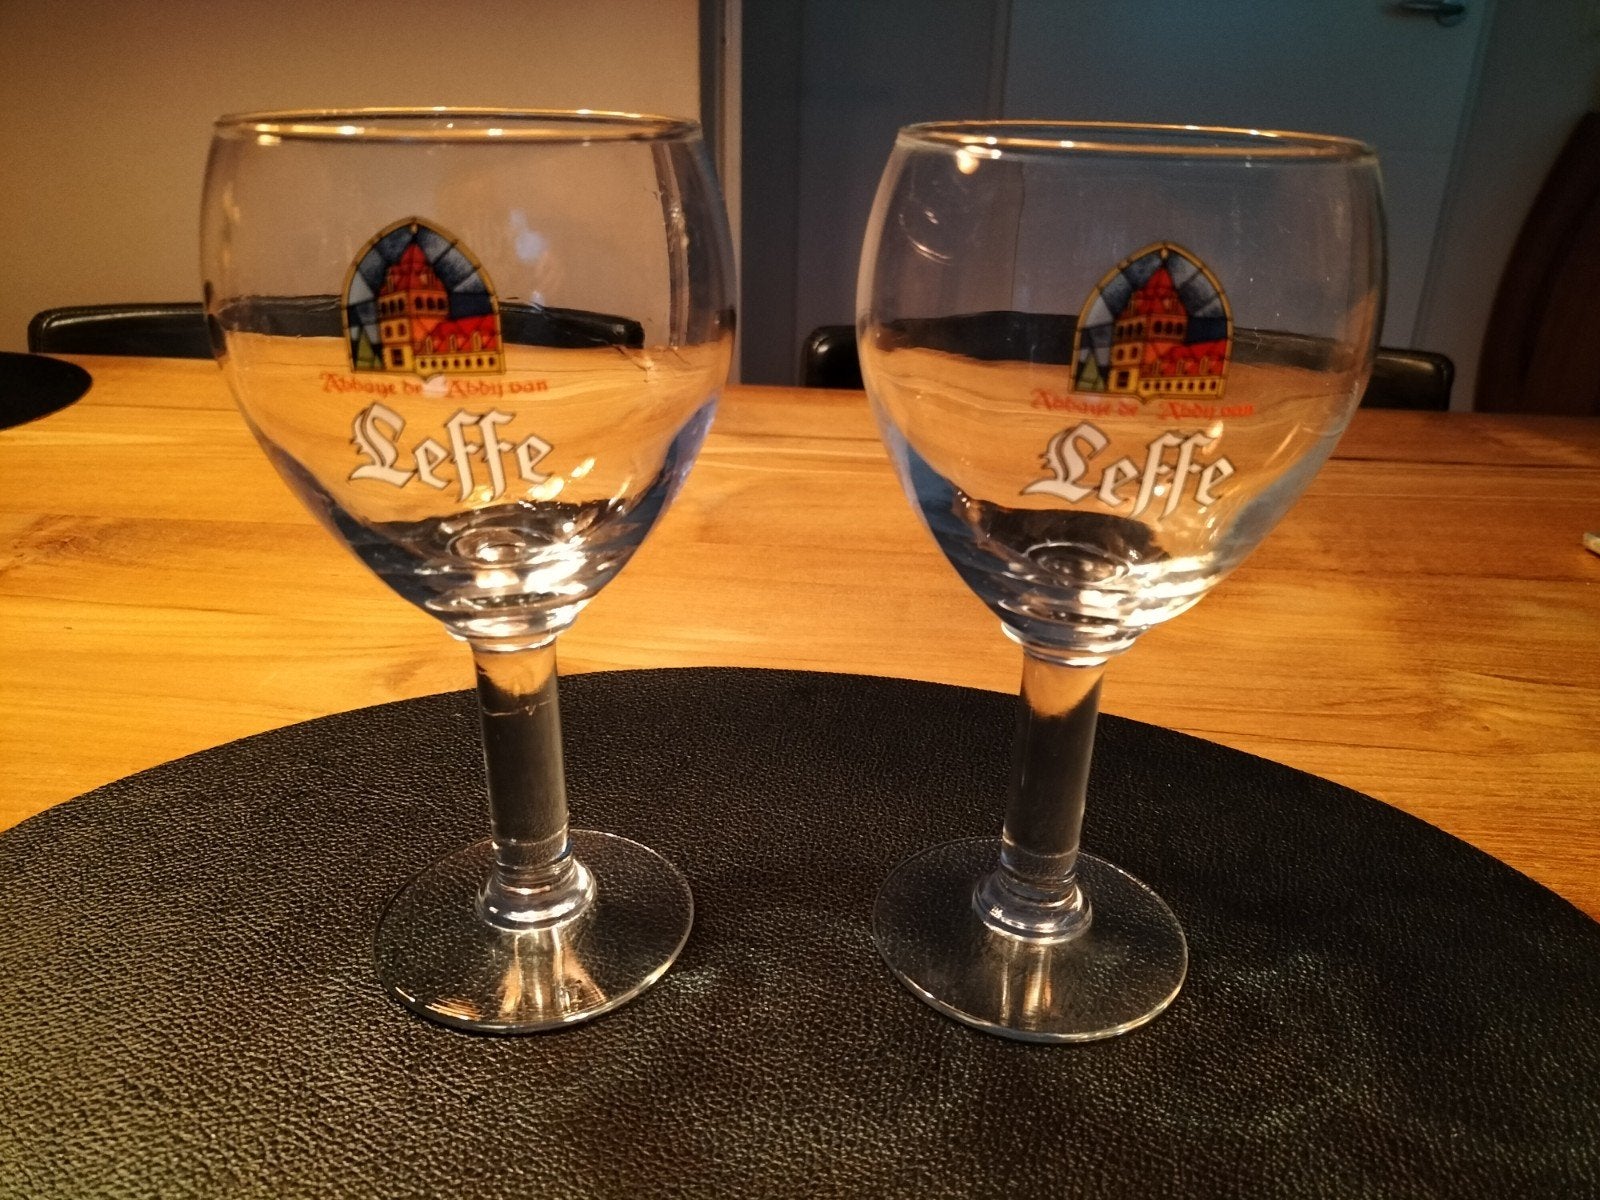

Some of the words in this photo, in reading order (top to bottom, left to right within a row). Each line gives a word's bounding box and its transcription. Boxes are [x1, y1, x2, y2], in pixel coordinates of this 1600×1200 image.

[320, 371, 396, 398] Abbaye
[508, 378, 549, 394] van
[348, 400, 554, 502] Leffe
[1019, 420, 1235, 522] Leffe
